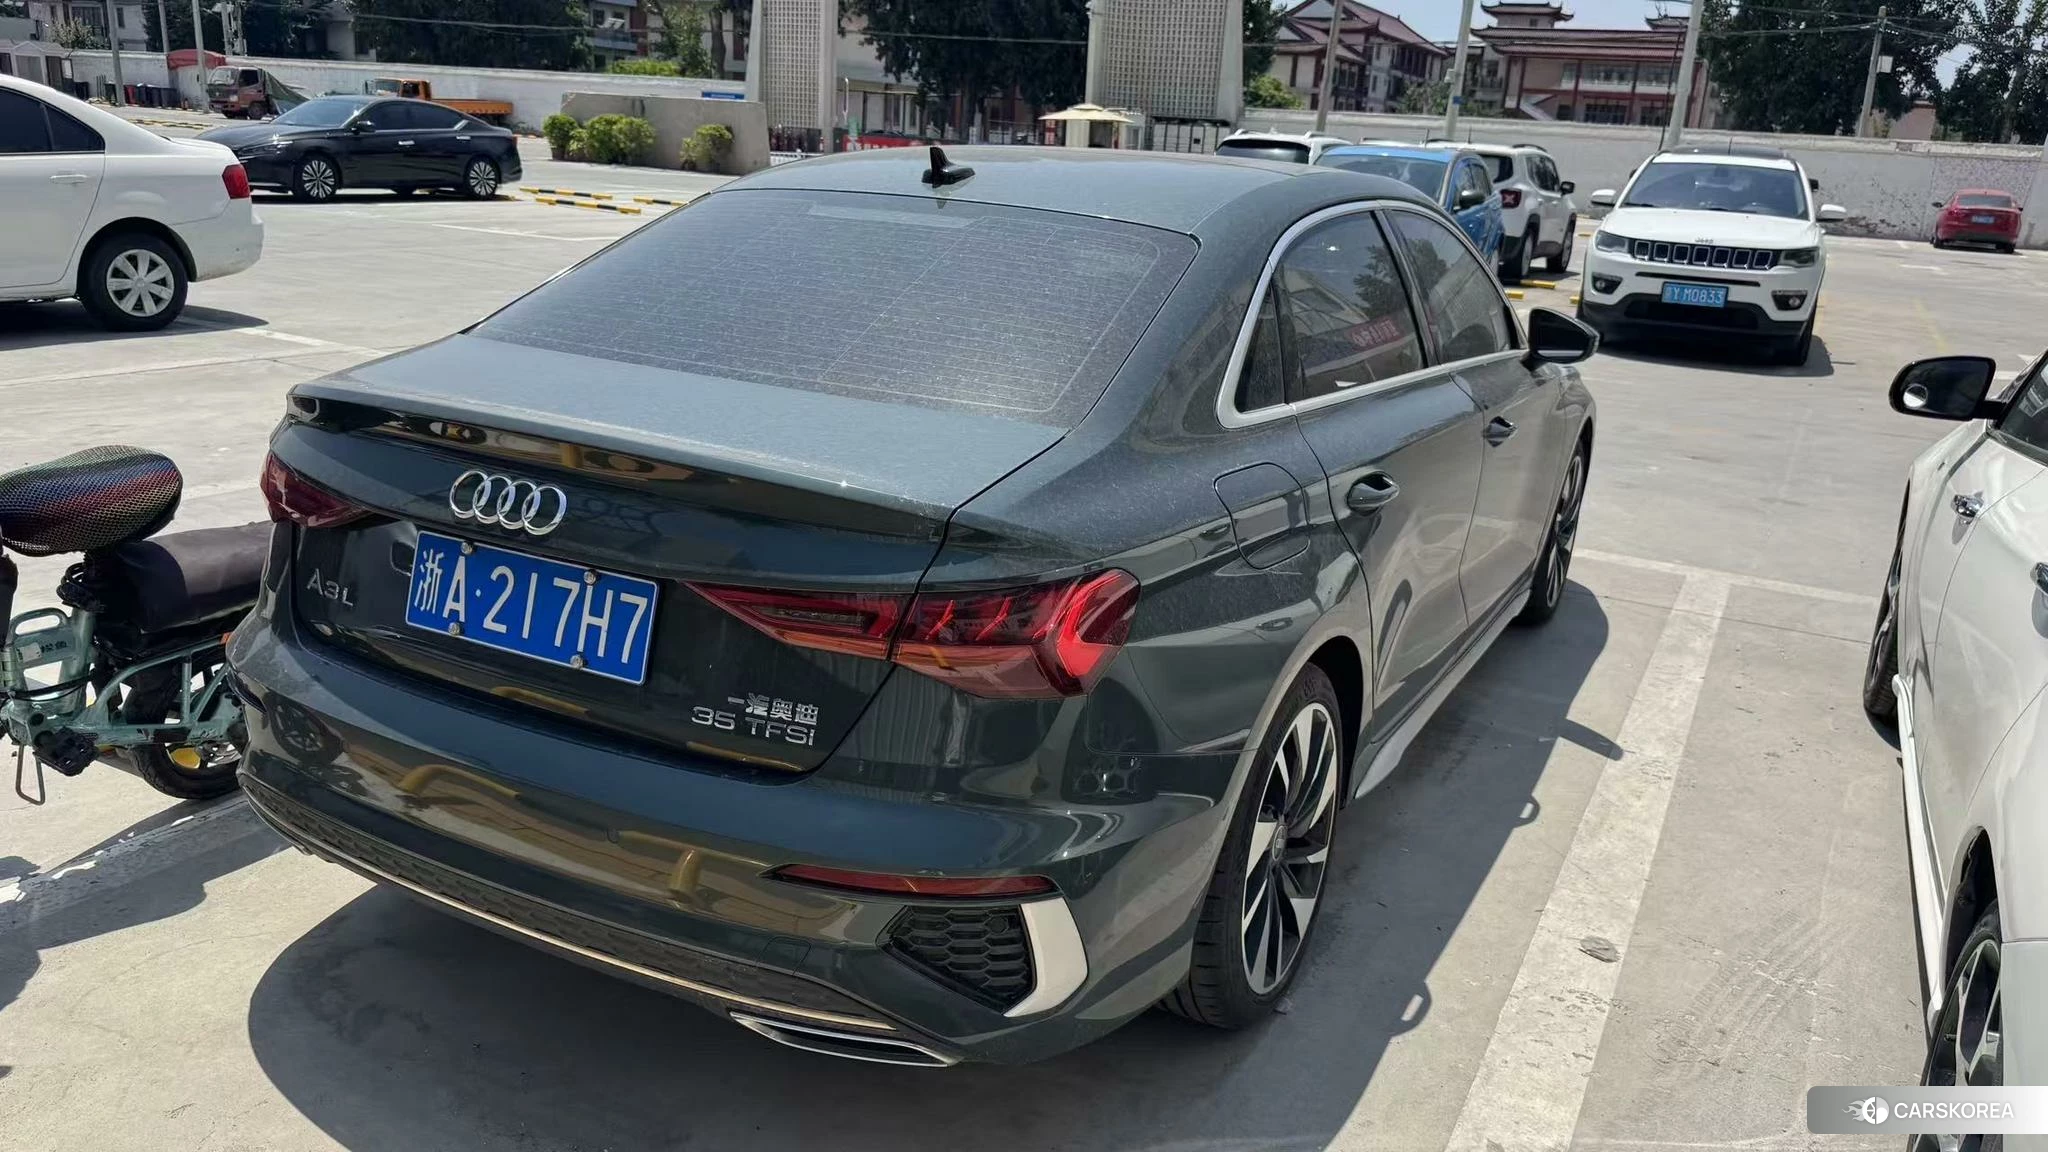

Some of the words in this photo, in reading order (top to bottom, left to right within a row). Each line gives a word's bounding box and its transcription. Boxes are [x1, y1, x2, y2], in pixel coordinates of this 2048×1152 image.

[307, 568, 354, 606] A3L
[413, 549, 648, 664] 浙A·217H7
[691, 706, 736, 730] 35
[728, 692, 819, 726] 一汽奥迪
